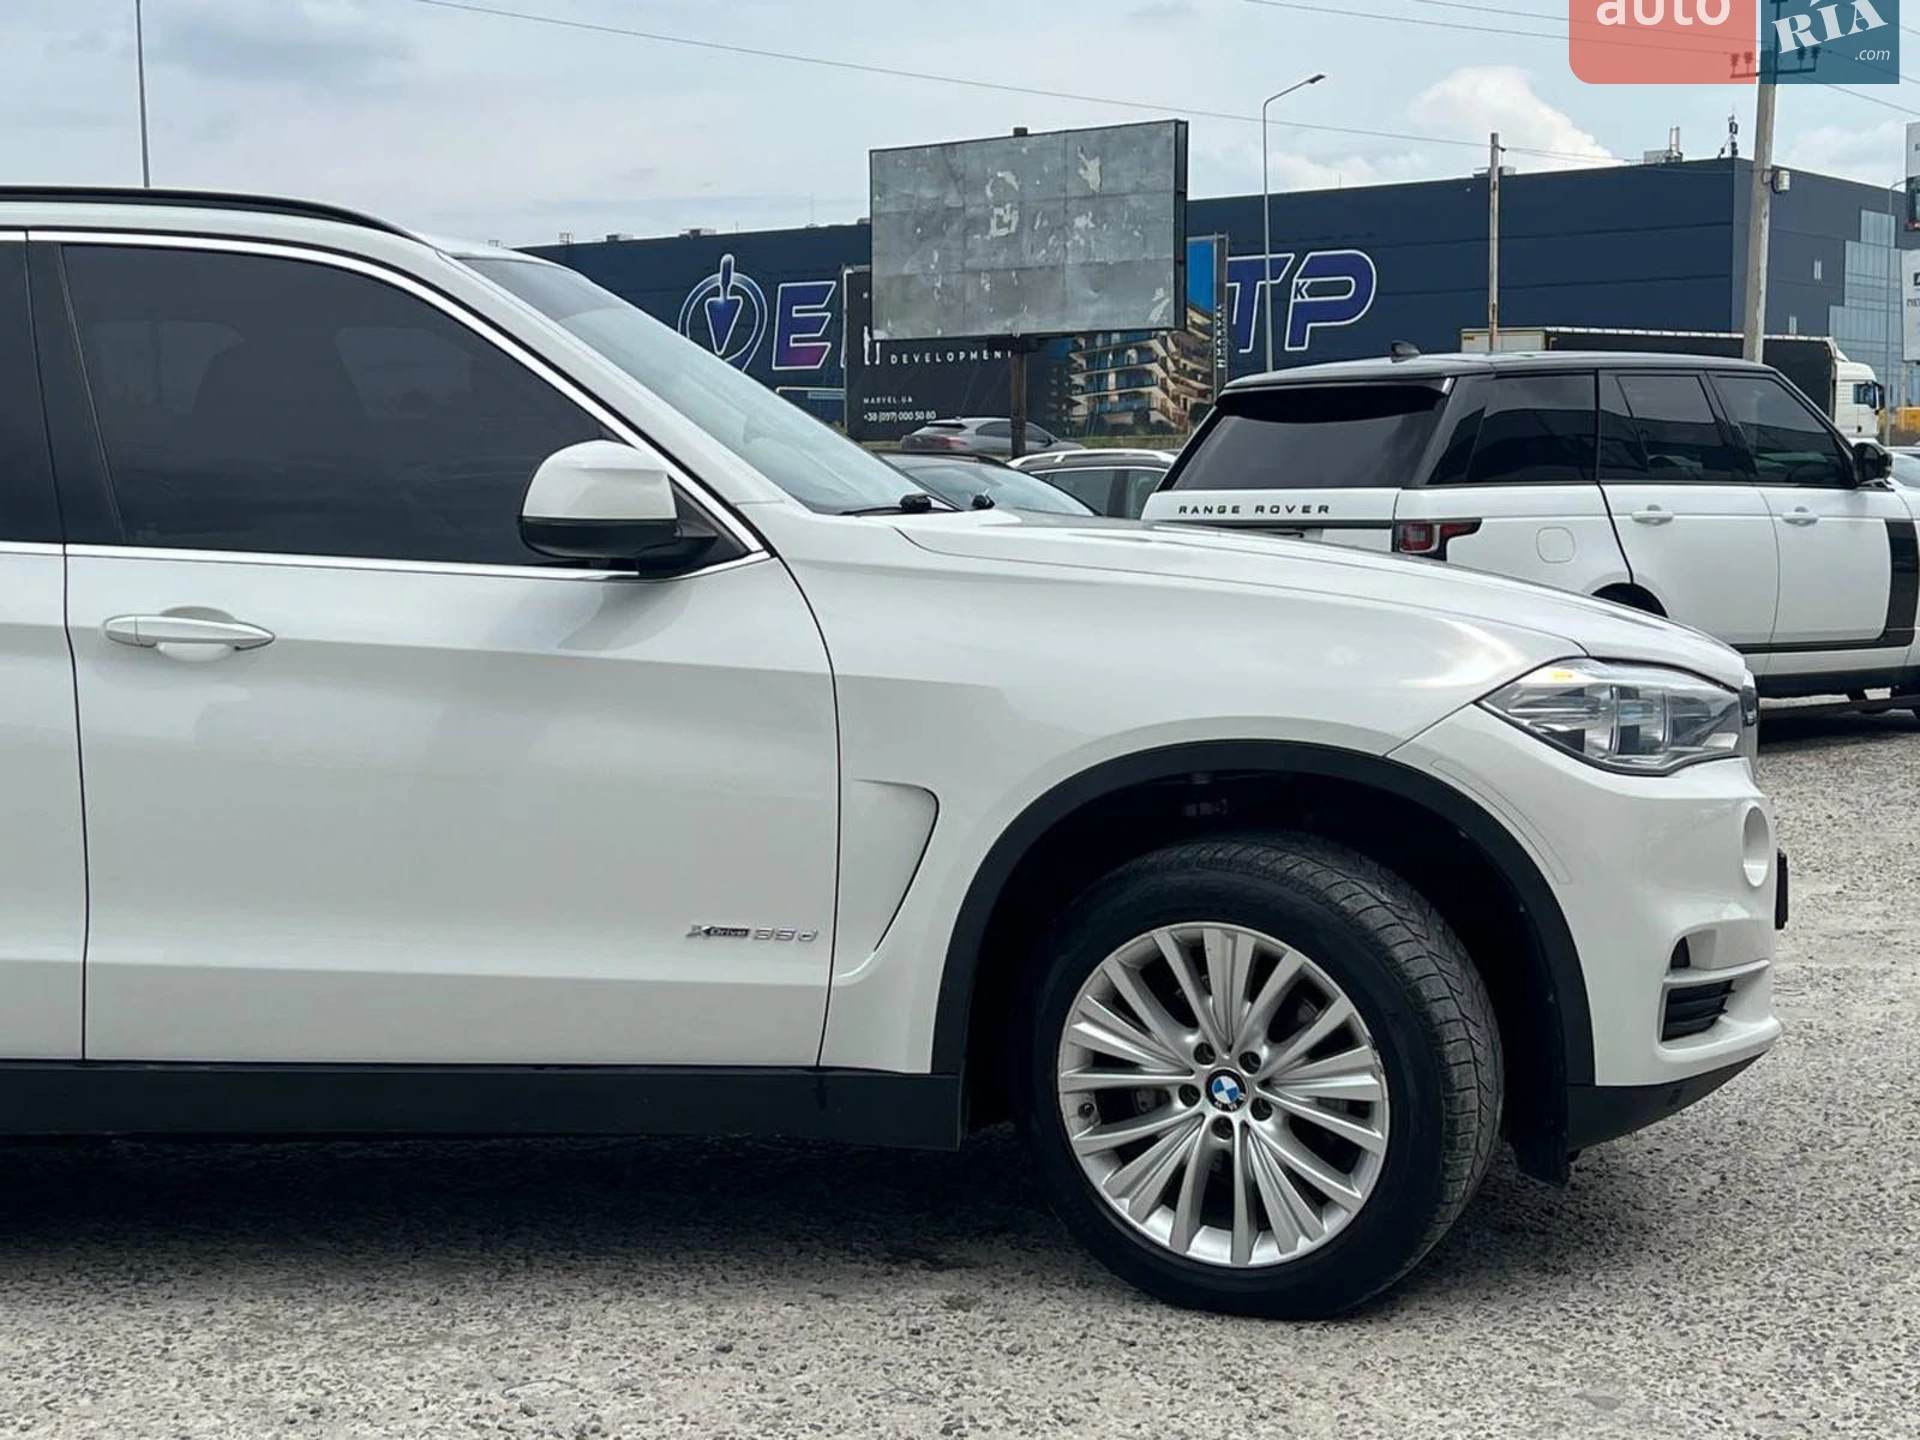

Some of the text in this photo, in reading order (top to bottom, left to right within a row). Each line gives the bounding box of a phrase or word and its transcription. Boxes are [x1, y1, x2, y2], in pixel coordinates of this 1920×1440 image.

[863, 412, 878, 422] +38
[1178, 504, 1330, 514] RANGE ROVER
